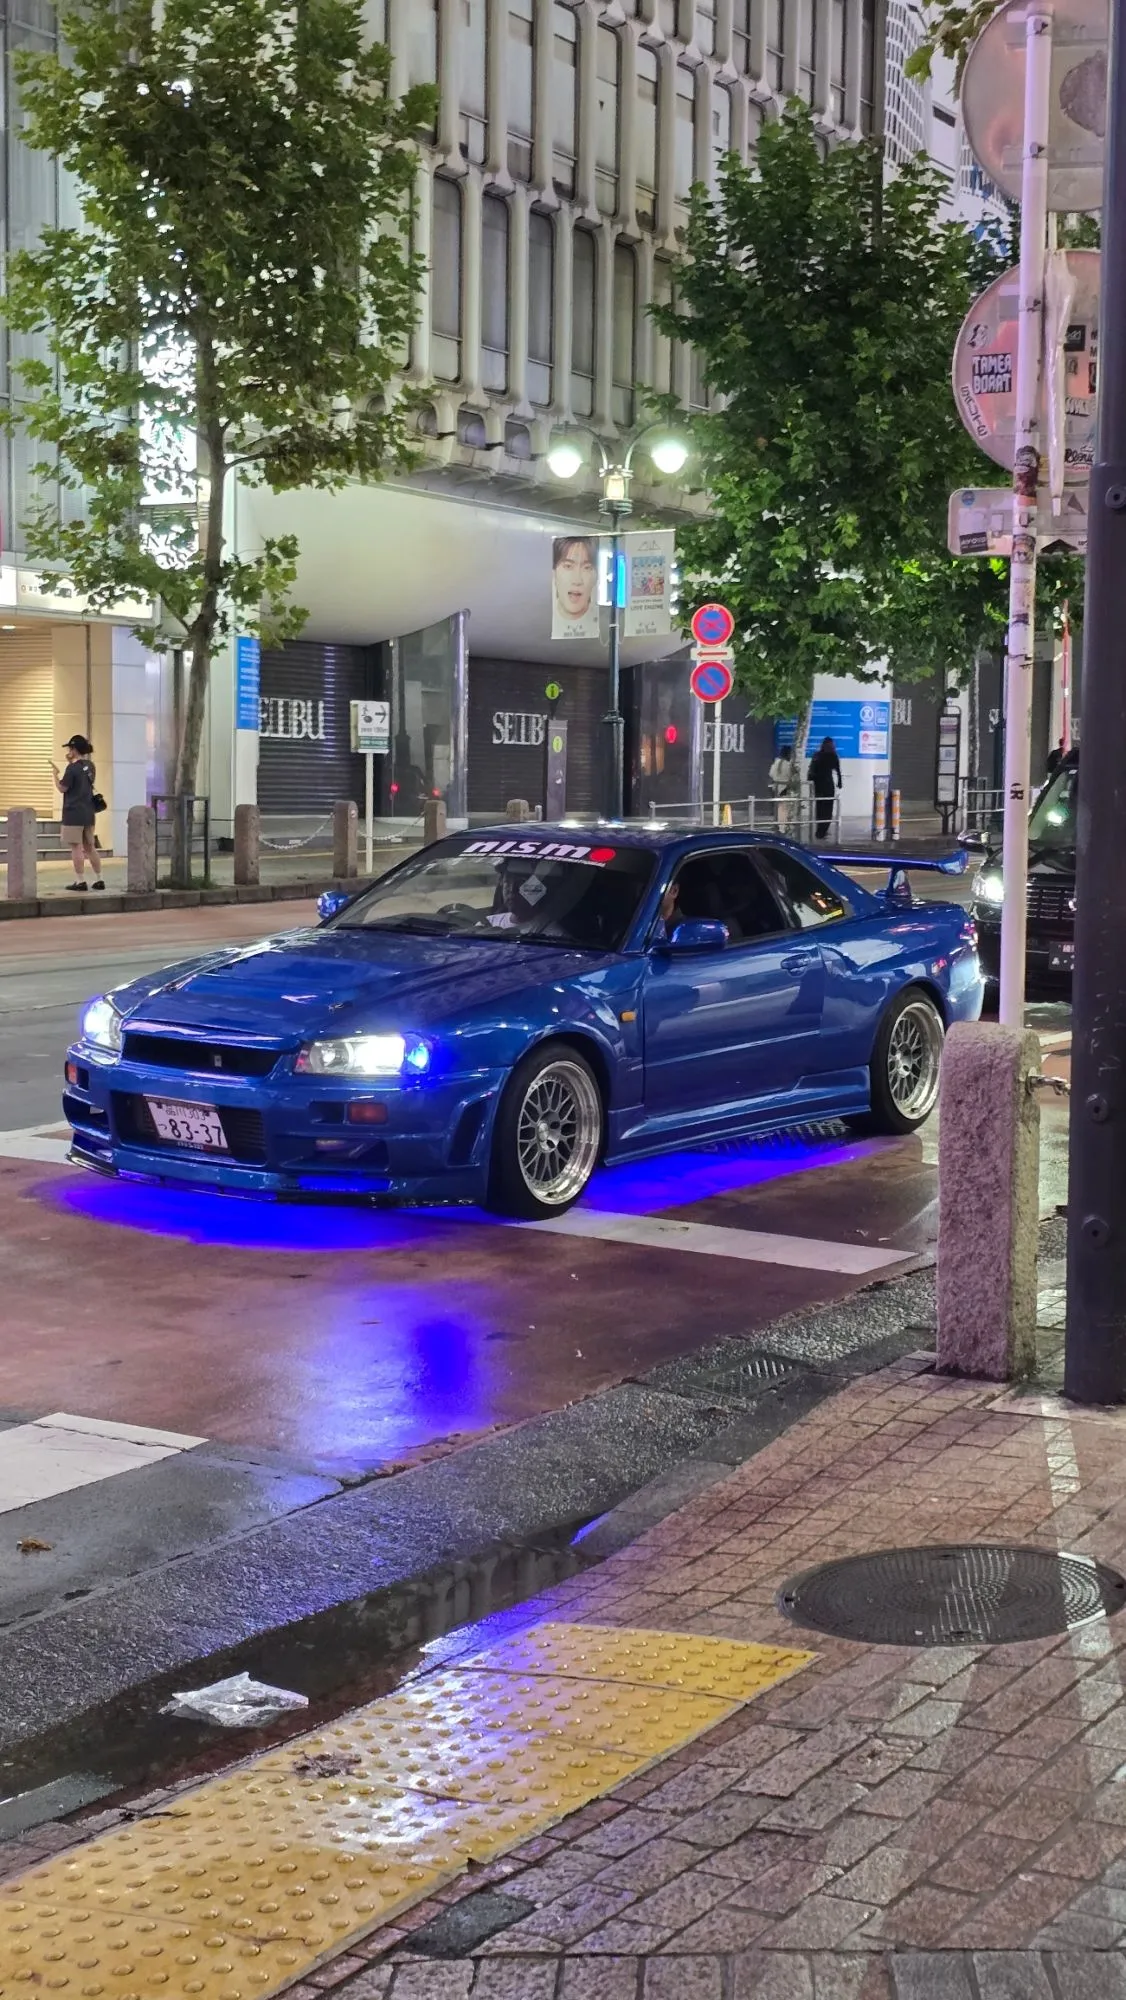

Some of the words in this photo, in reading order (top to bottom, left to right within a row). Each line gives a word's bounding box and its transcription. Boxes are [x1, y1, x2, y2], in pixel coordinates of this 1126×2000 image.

[258, 697, 326, 739] EIBU
[492, 712, 548, 745] SEIB
[169, 1119, 222, 1146] 83-37
